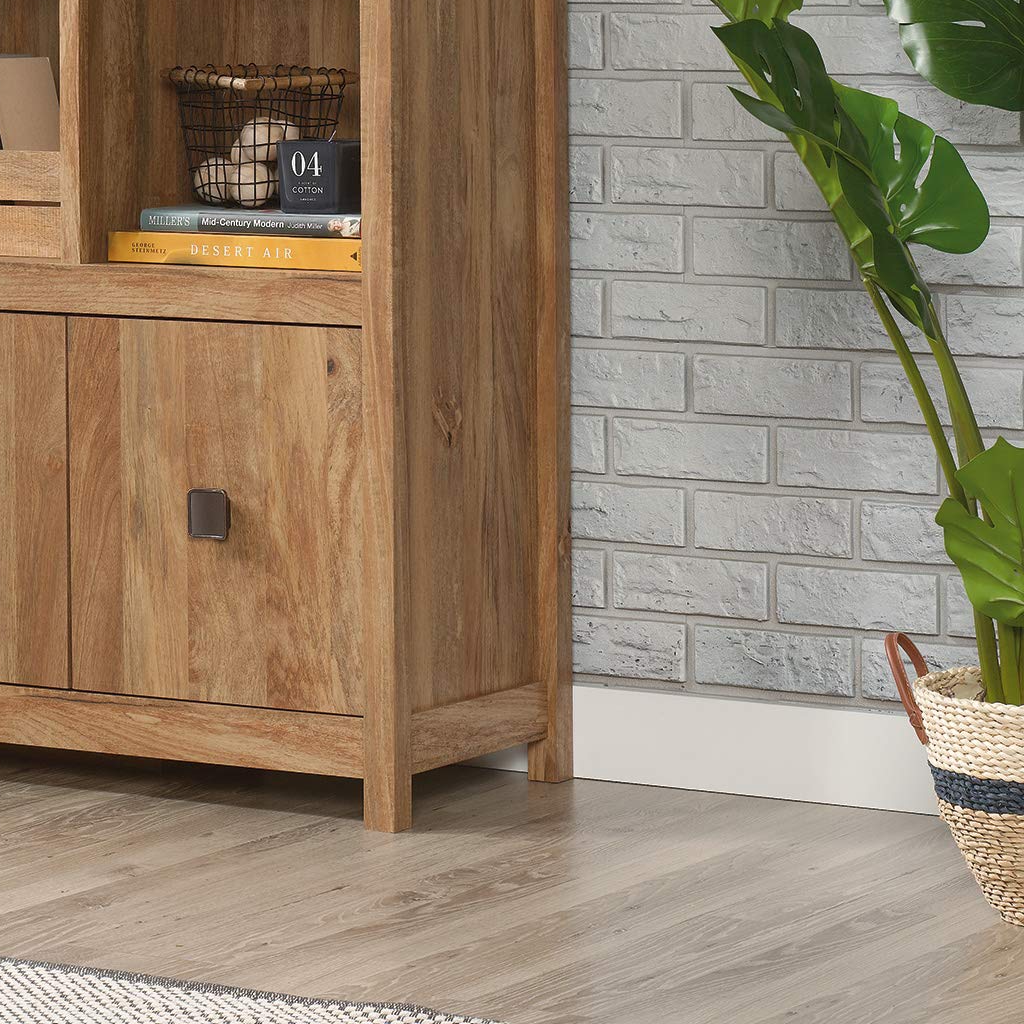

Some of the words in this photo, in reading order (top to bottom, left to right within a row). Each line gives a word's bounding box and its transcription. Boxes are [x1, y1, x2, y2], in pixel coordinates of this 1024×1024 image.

[292, 151, 323, 177] 04
[292, 186, 324, 194] COTTON
[149, 216, 191, 227] MILLER'S
[202, 218, 251, 228] Mid-Century
[253, 220, 284, 228] Modern
[191, 245, 254, 257] DESERT
[263, 248, 293, 259] AIR
